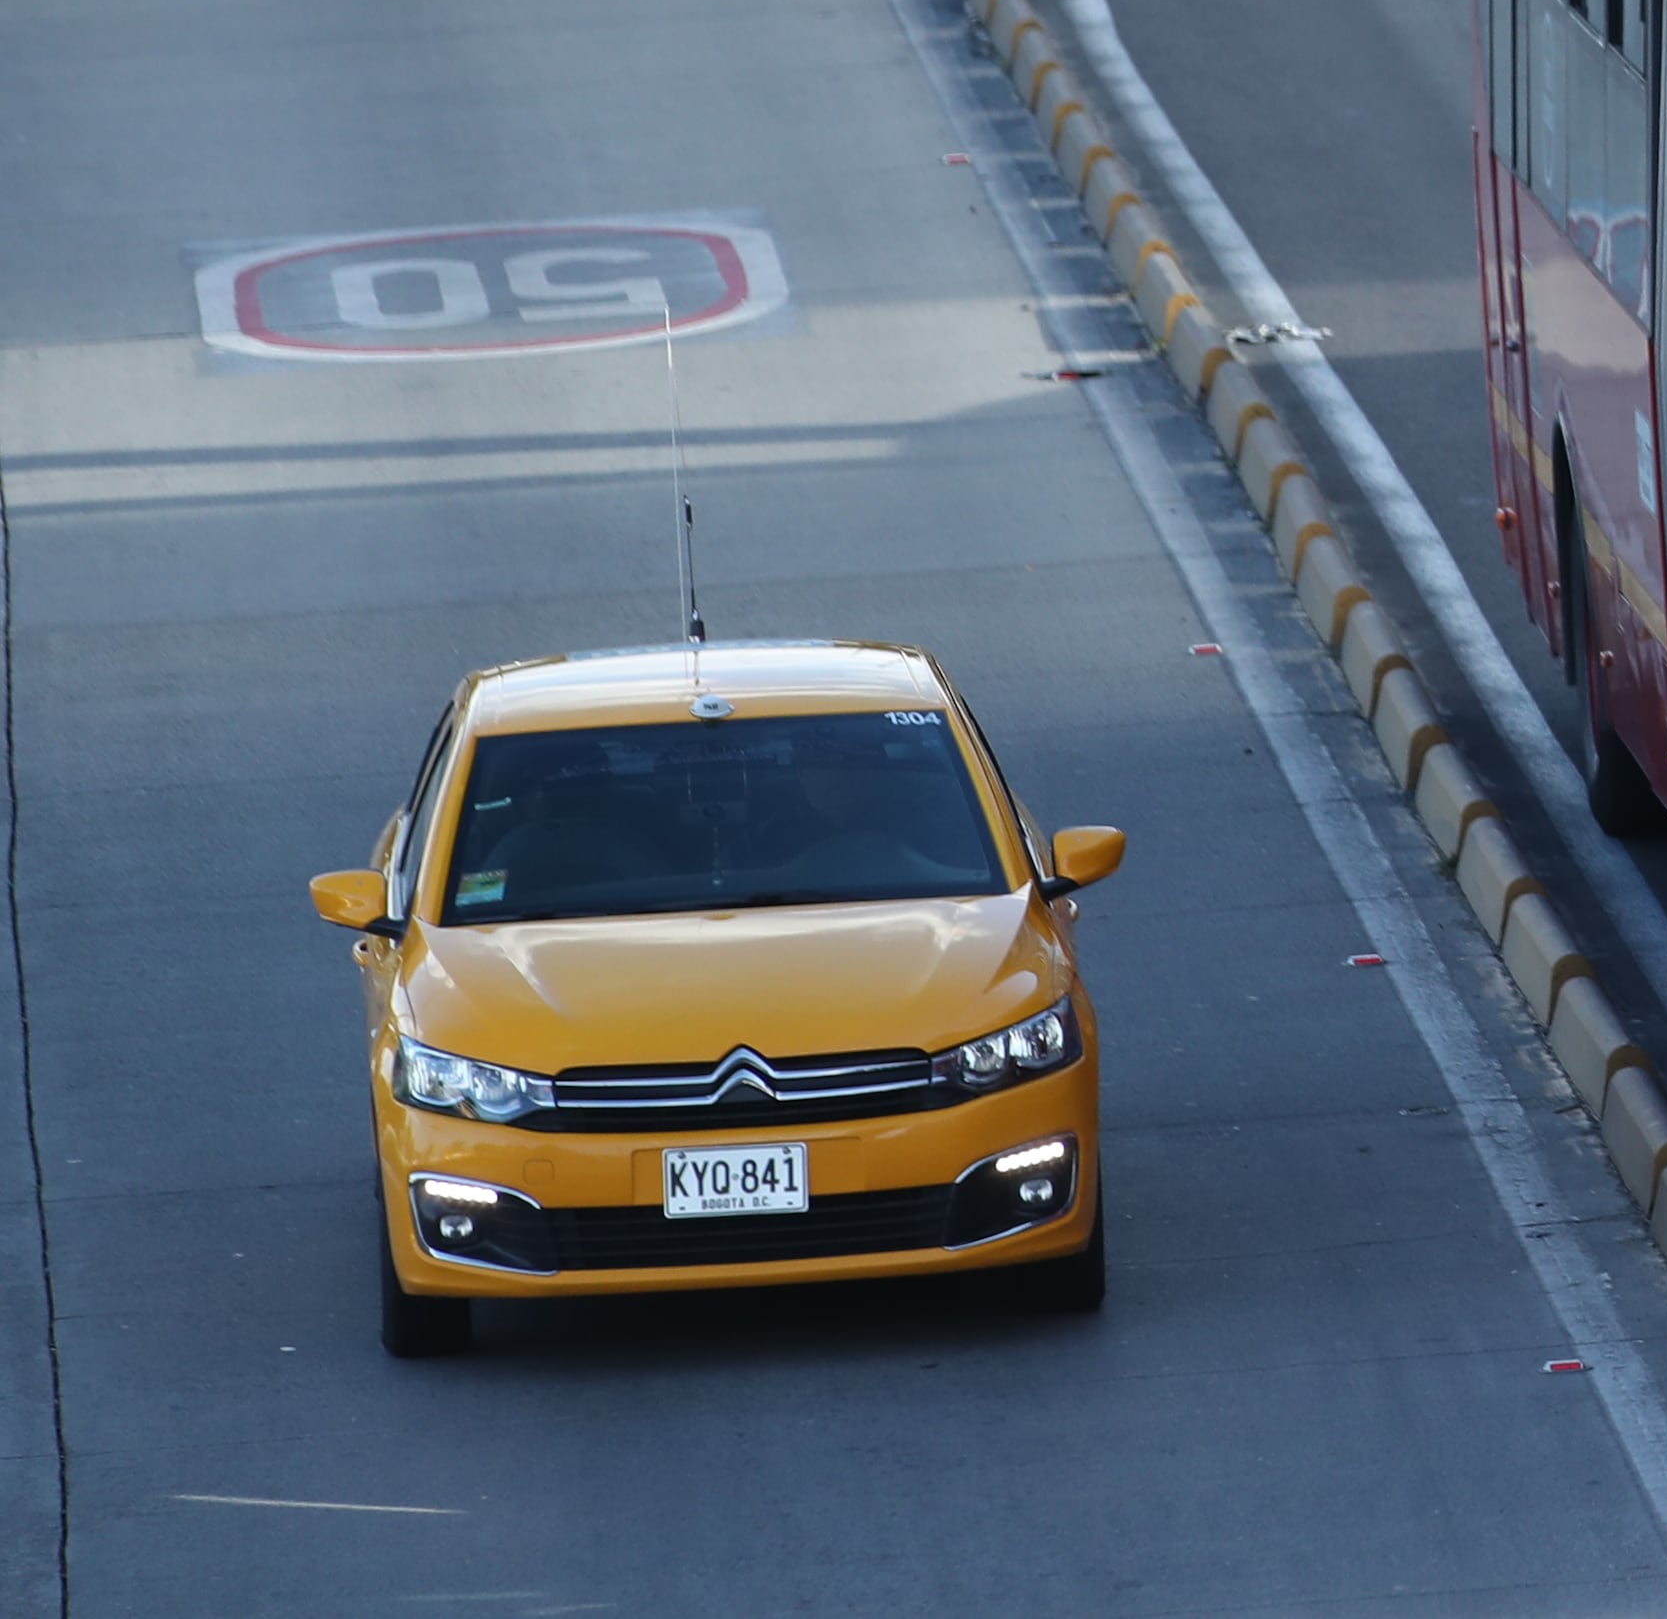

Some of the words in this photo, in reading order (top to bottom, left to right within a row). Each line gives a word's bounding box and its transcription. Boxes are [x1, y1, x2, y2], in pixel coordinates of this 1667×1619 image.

[331, 247, 670, 330] 50
[884, 711, 942, 727] 1304
[701, 1198, 746, 1210] BOGOTA
